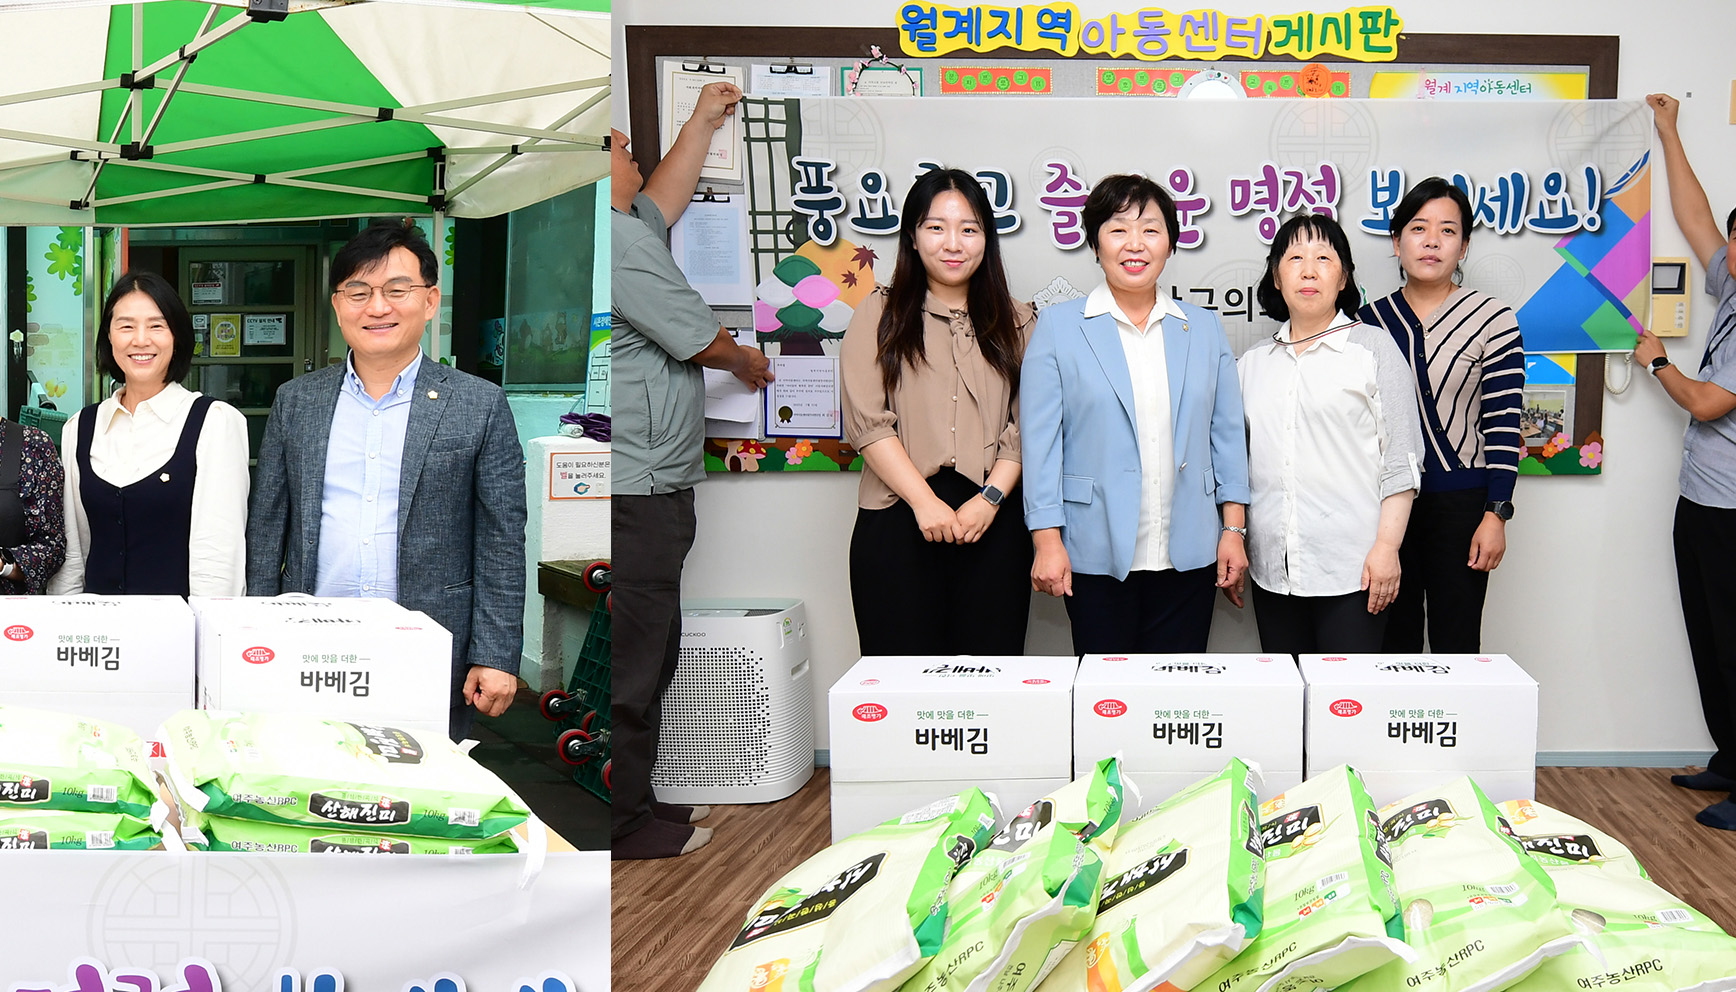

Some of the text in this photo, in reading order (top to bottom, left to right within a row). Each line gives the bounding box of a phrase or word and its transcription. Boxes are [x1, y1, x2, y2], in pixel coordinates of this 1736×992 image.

[1082, 11, 1261, 56] 아동센터
[1274, 9, 1393, 53] 게시판
[1425, 79, 1451, 95] 월계
[793, 161, 1601, 241] 풍요고 보세요!
[93, 635, 108, 643] 더한
[57, 647, 120, 671] 바베김
[341, 654, 357, 664] 더한
[300, 670, 370, 697] 바베김
[957, 710, 975, 720] 더한
[1192, 709, 1210, 719] 더한
[1427, 709, 1444, 718] 더한
[915, 726, 989, 755] 바베김
[1152, 722, 1223, 749] 바베김
[1387, 721, 1457, 748] 바베김
[321, 800, 396, 823] 산해진미
[423, 809, 445, 821] 10kg
[1406, 939, 1485, 989] 여주농산RPC
[1577, 957, 1664, 991] 여주농산RPC
